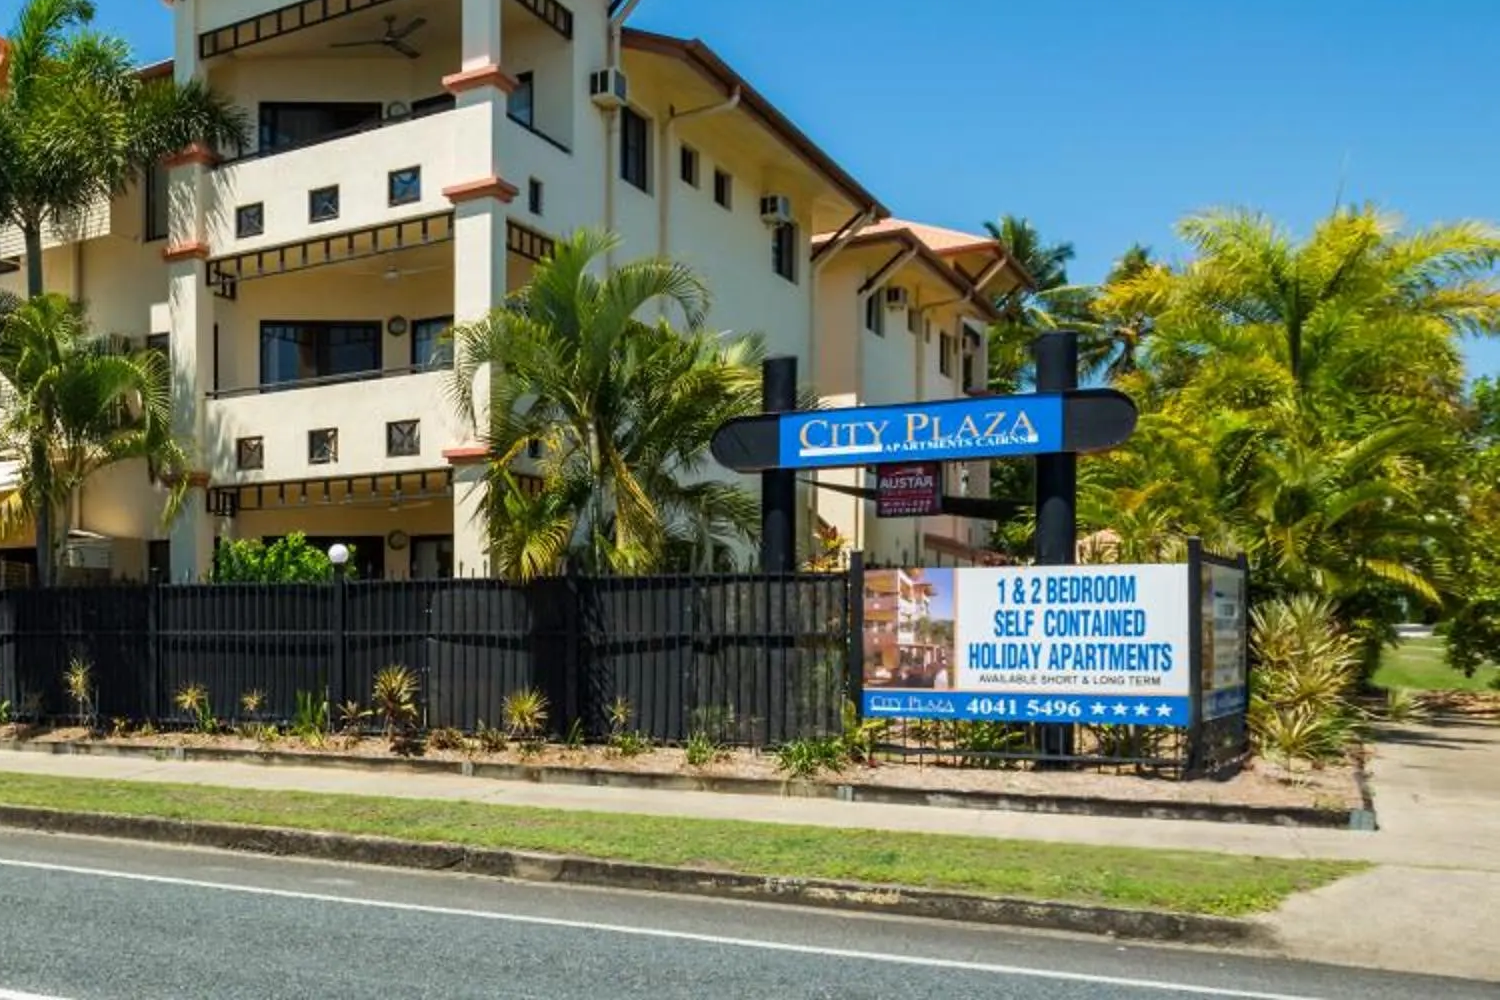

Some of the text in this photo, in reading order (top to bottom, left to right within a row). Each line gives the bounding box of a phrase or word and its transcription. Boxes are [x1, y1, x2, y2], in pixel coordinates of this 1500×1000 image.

[799, 411, 1037, 449] CITY PLAZA
[880, 476, 933, 489] AUSTAR
[997, 575, 1136, 604] 1 & 2 BEDROOM
[994, 609, 1146, 637] SELF CONTAINED
[969, 642, 1172, 672] HOLIDAY APARTMENTS
[979, 674, 1161, 686] AVAILABLE SHORT & LONG TERM
[966, 698, 1017, 715] 4041
[1026, 699, 1082, 717] 5496
